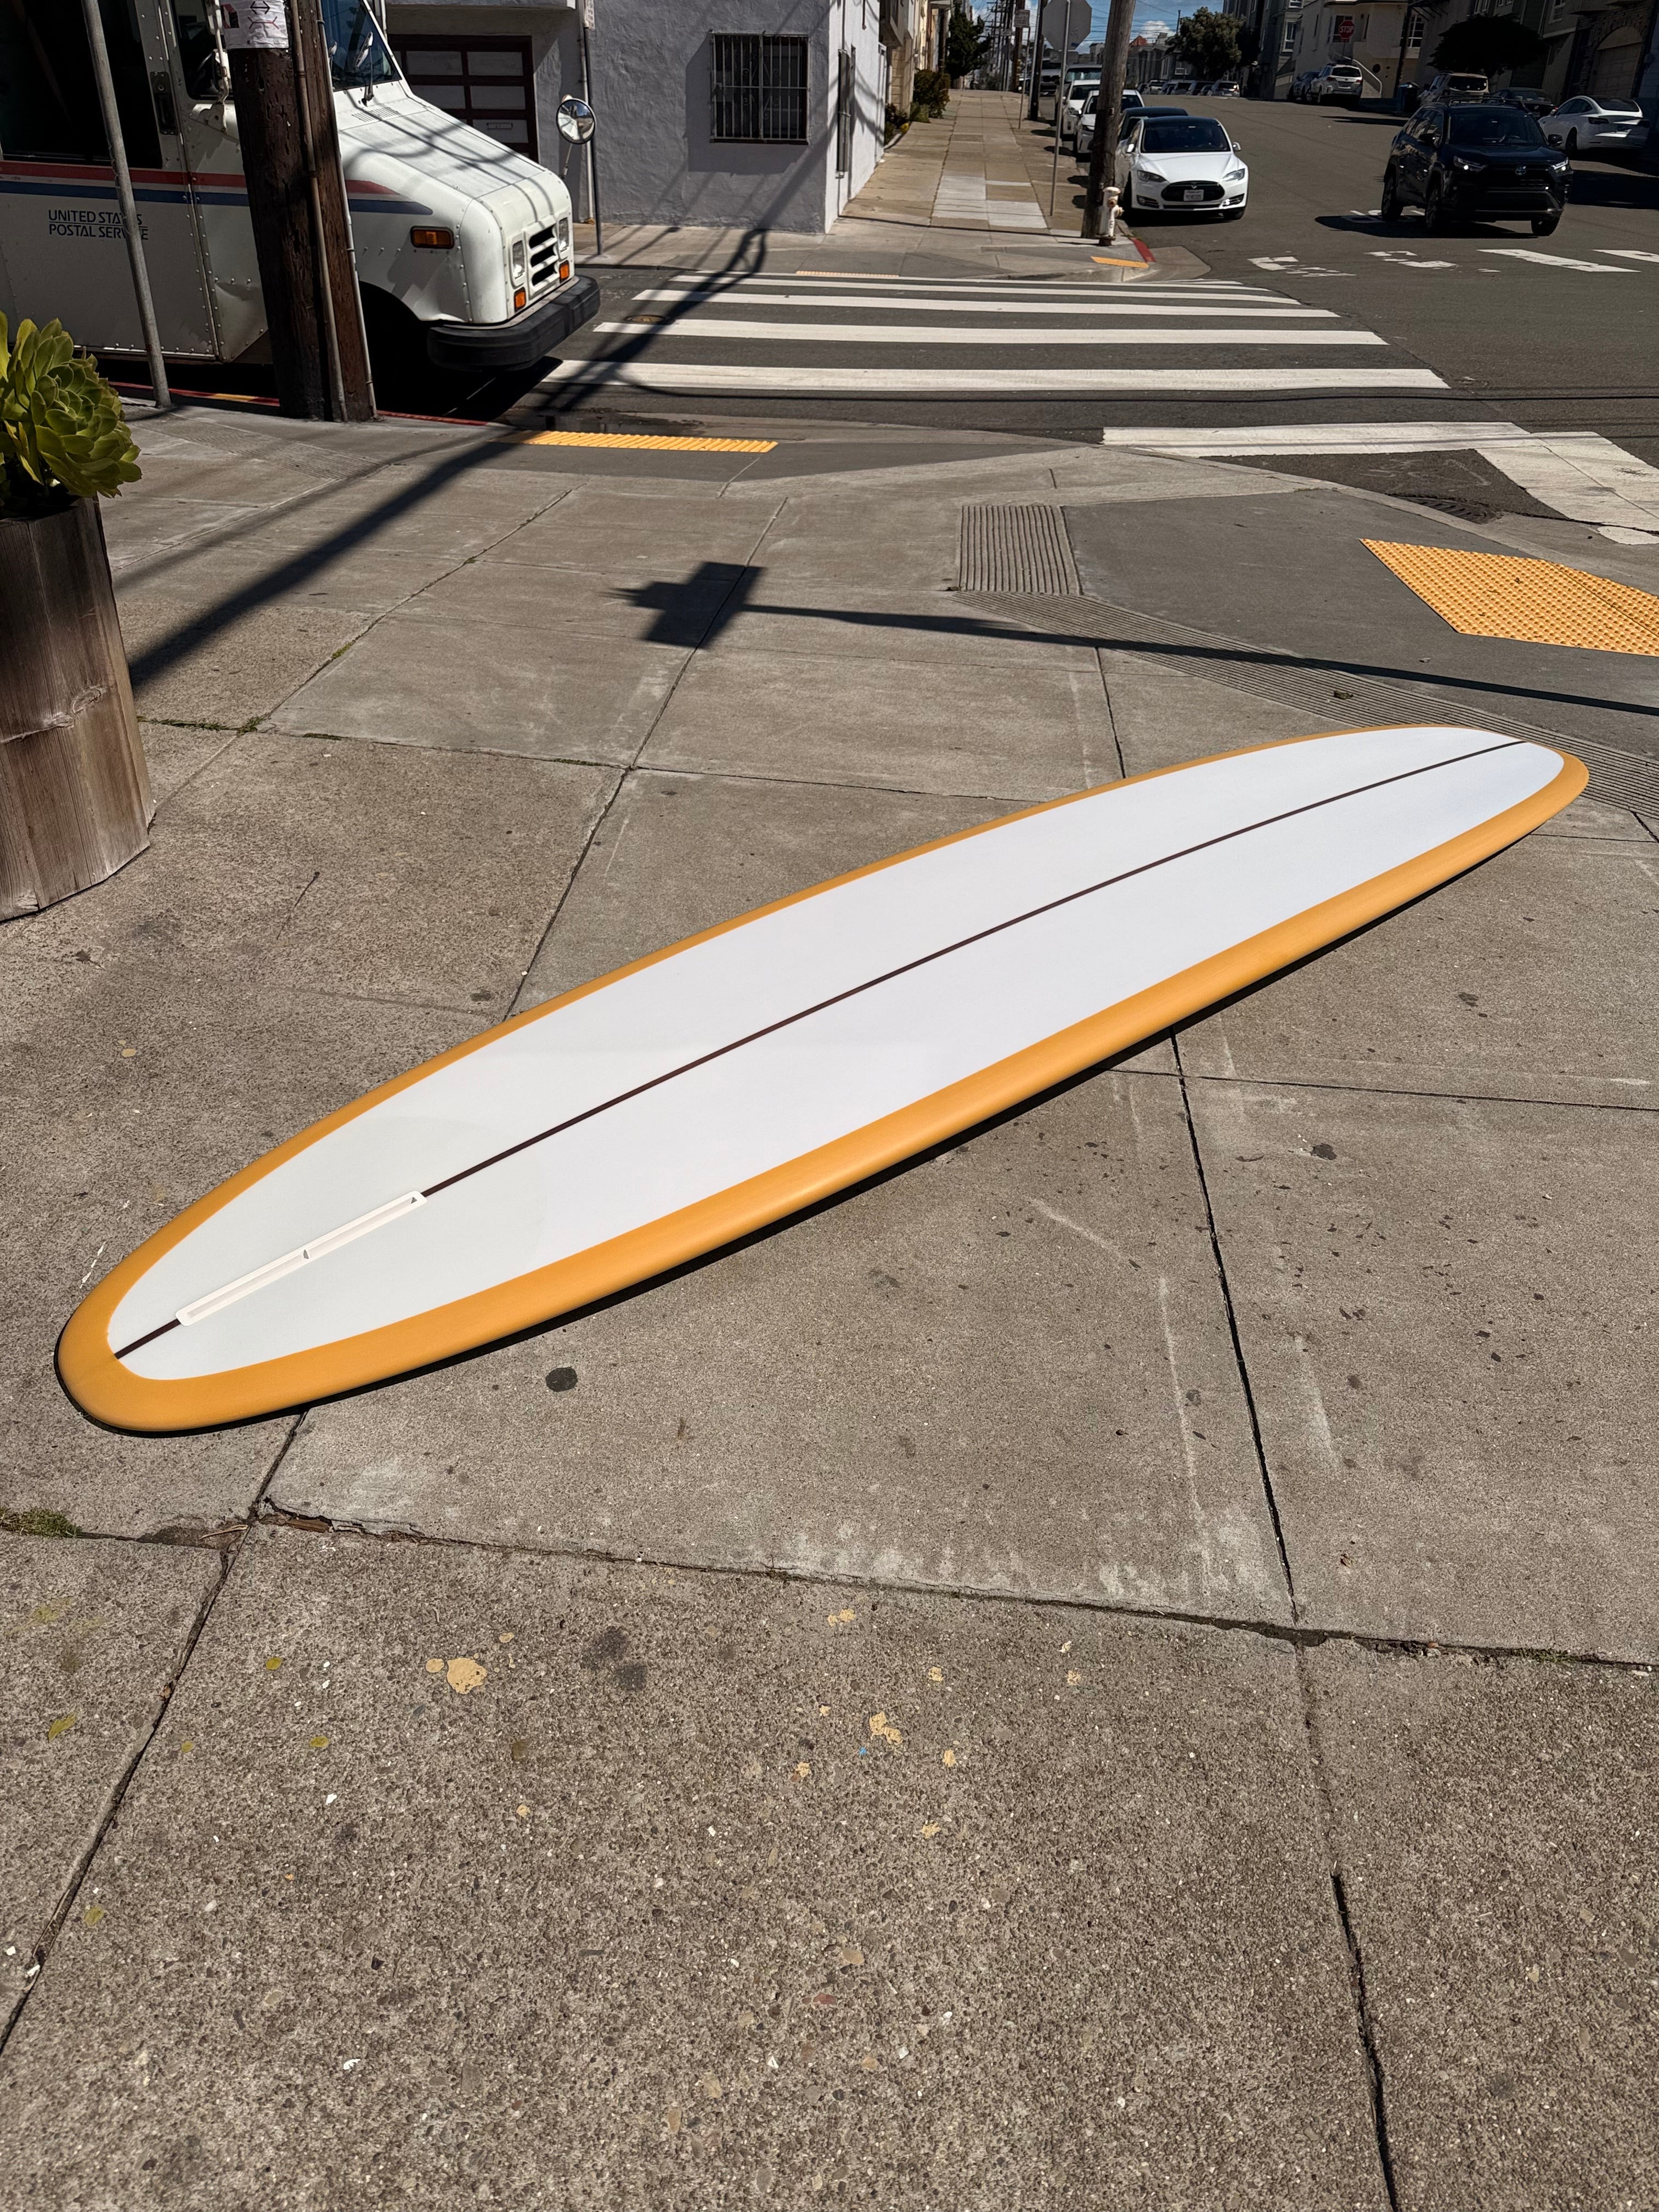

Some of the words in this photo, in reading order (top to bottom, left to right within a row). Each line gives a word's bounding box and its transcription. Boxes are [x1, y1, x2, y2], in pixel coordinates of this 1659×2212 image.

[48, 210, 96, 223] UNITED
[99, 212, 143, 225] STAS
[49, 224, 96, 237] POSTAL
